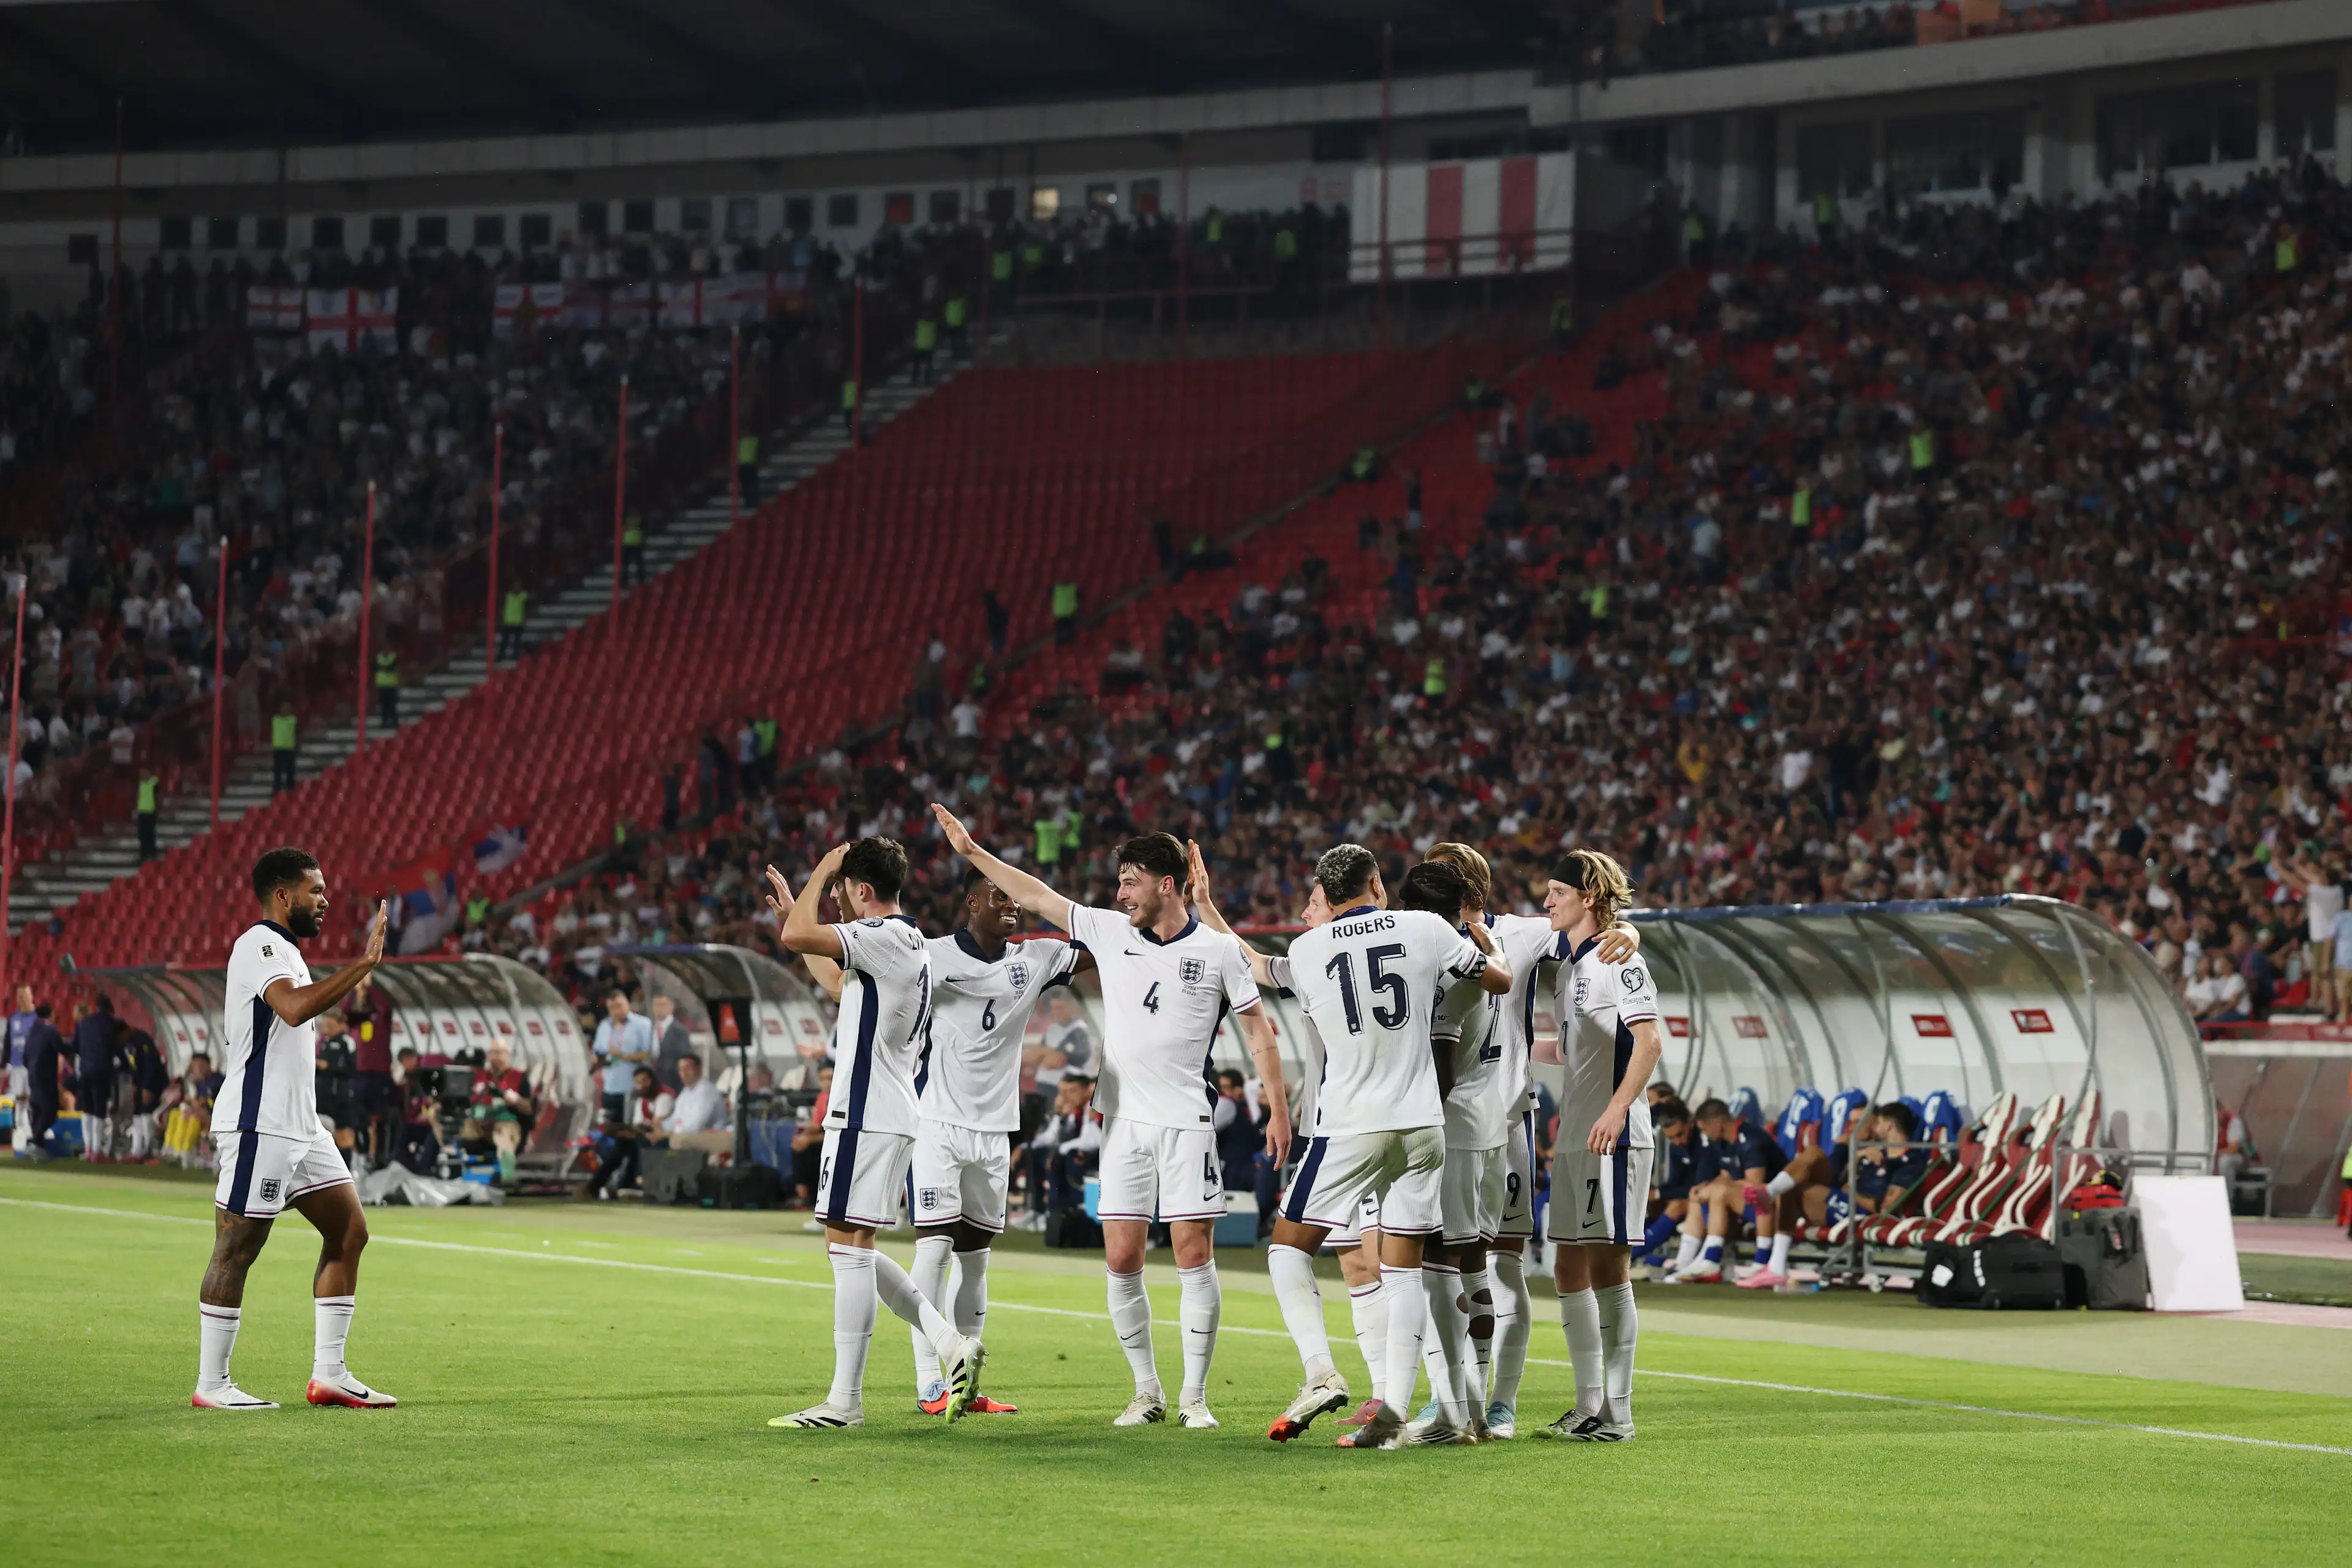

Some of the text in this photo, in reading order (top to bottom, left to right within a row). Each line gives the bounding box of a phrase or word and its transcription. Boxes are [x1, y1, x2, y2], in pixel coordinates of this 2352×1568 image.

[1332, 915, 1395, 939] ROGERS
[1143, 981, 1161, 1016] 4
[1325, 943, 1410, 1036] 15
[982, 999, 997, 1032] 6
[1204, 1152, 1219, 1186] 4
[1507, 1172, 1521, 1208] 9
[1586, 1178, 1600, 1214] 7
